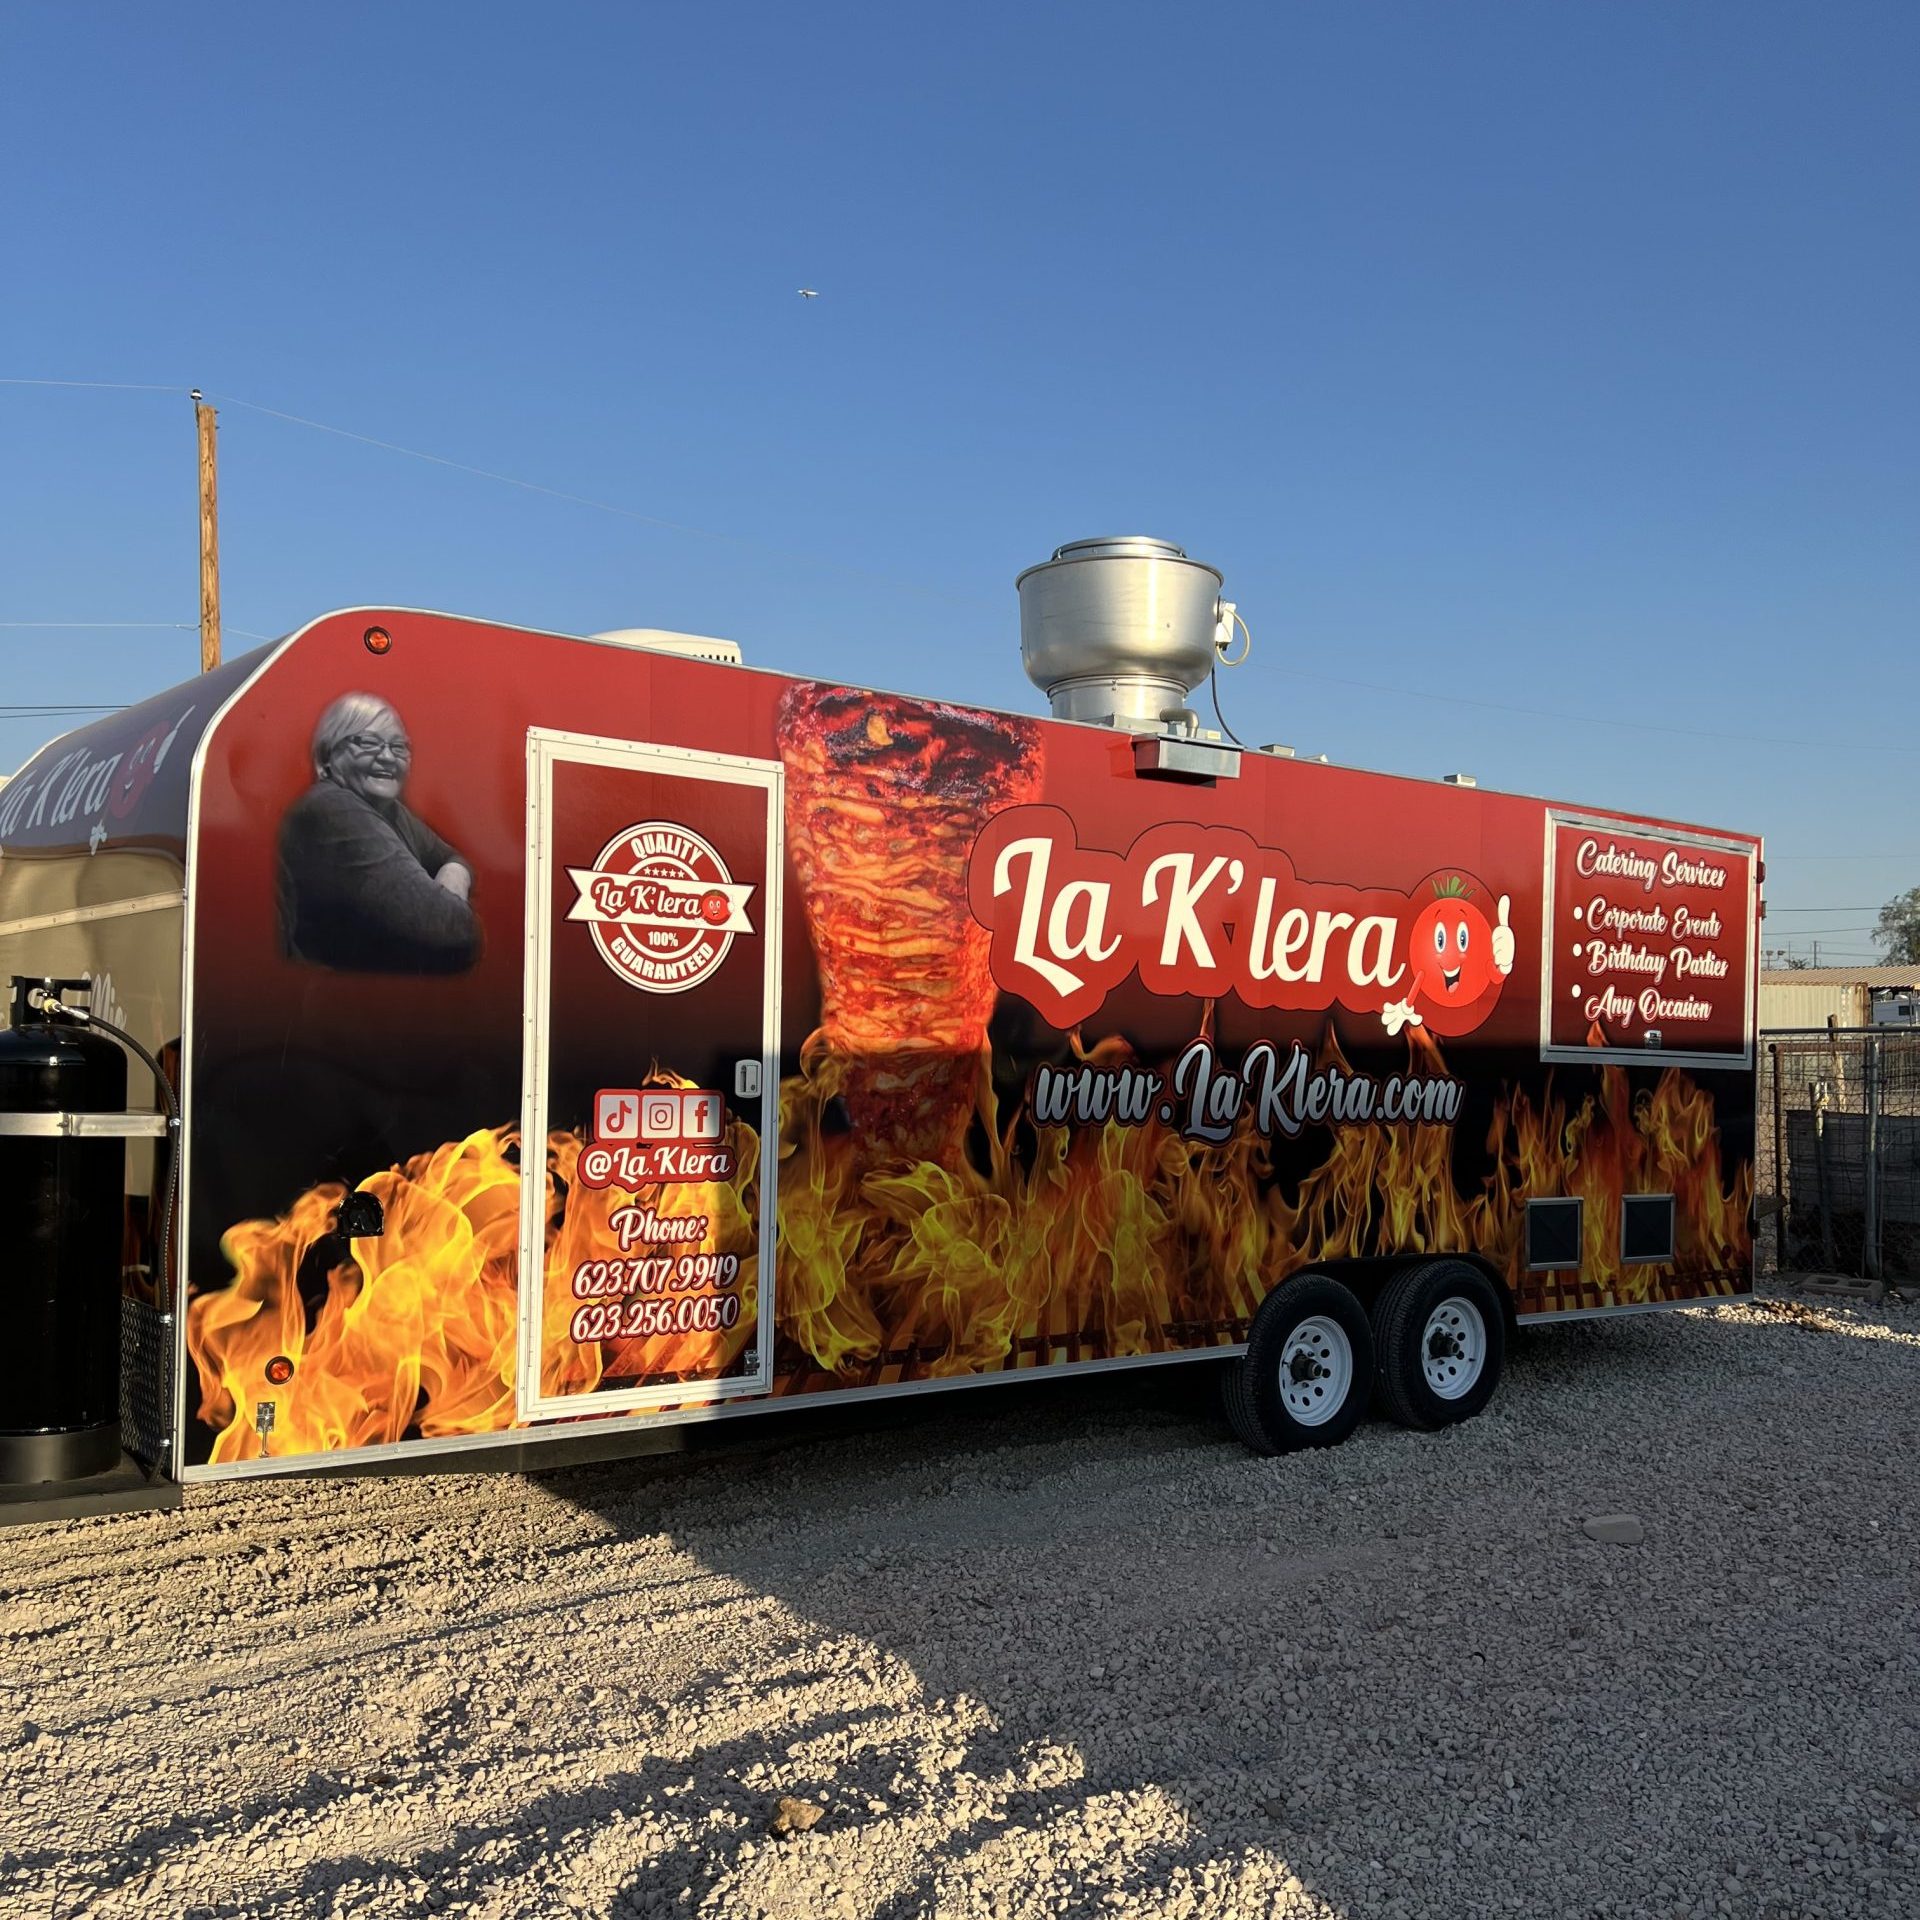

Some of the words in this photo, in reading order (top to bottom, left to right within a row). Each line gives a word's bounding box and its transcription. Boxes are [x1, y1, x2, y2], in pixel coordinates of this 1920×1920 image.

[630, 833, 703, 866] QUALITY
[1577, 839, 1658, 890] Catering
[1661, 851, 1727, 888] Services
[595, 882, 626, 914] La
[993, 837, 1122, 998] La
[1587, 897, 1668, 940] Corporate
[1672, 906, 1722, 940] Events
[610, 936, 714, 980] GUARANTEED
[648, 931, 679, 947] 100%
[1586, 941, 1667, 983] Birthday
[1670, 947, 1728, 981] Parties
[1585, 984, 1635, 1028] Any
[611, 1207, 706, 1250] Phone:
[575, 1255, 737, 1296] 623.707.9949
[573, 1296, 738, 1341] 623.256.0050
